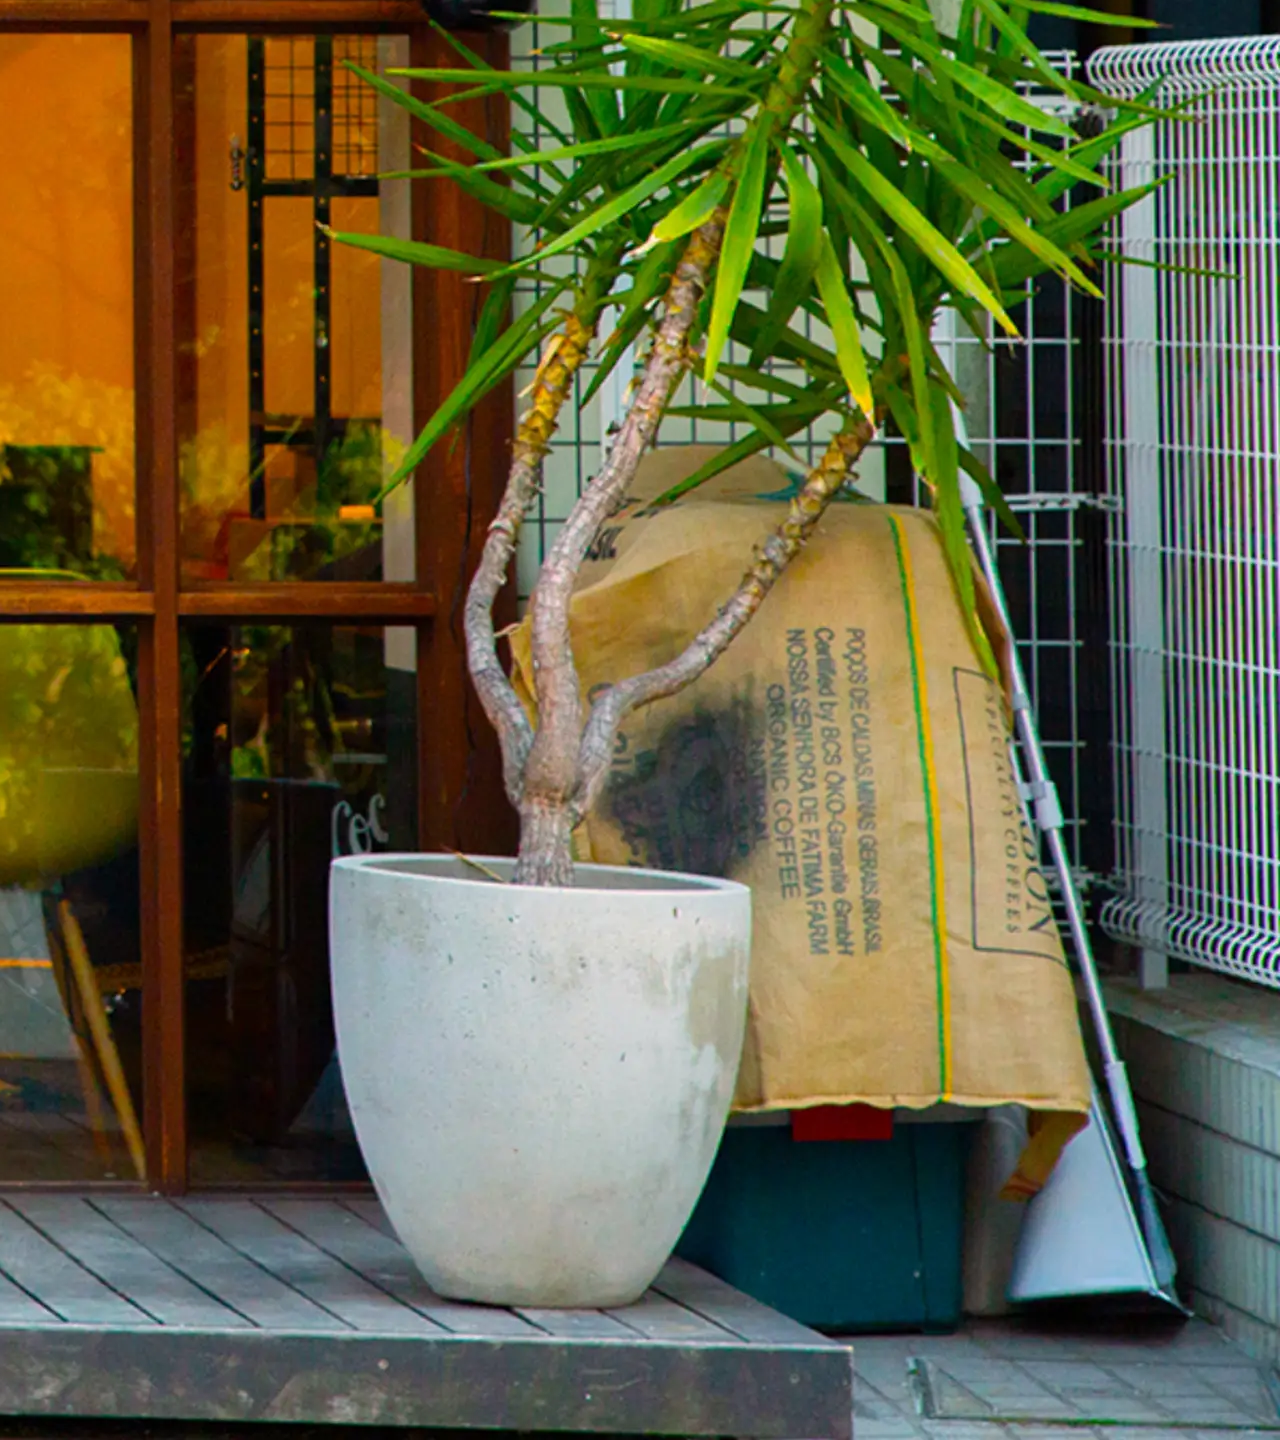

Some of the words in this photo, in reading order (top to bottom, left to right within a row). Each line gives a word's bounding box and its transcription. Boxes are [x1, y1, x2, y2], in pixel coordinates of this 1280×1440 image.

[788, 629, 810, 694] NOSSA
[815, 702, 838, 722] by
[850, 688, 869, 710] DE
[768, 684, 791, 791] ORGANIC
[792, 699, 815, 792] SENHORA
[821, 728, 842, 765] BCS
[799, 797, 818, 823] DE
[986, 693, 1012, 820] SPECIALTY
[1004, 830, 1020, 934] COFFEES
[773, 800, 799, 900] COFFEE
[807, 902, 829, 955] FARM
[833, 899, 854, 956] GmbH
